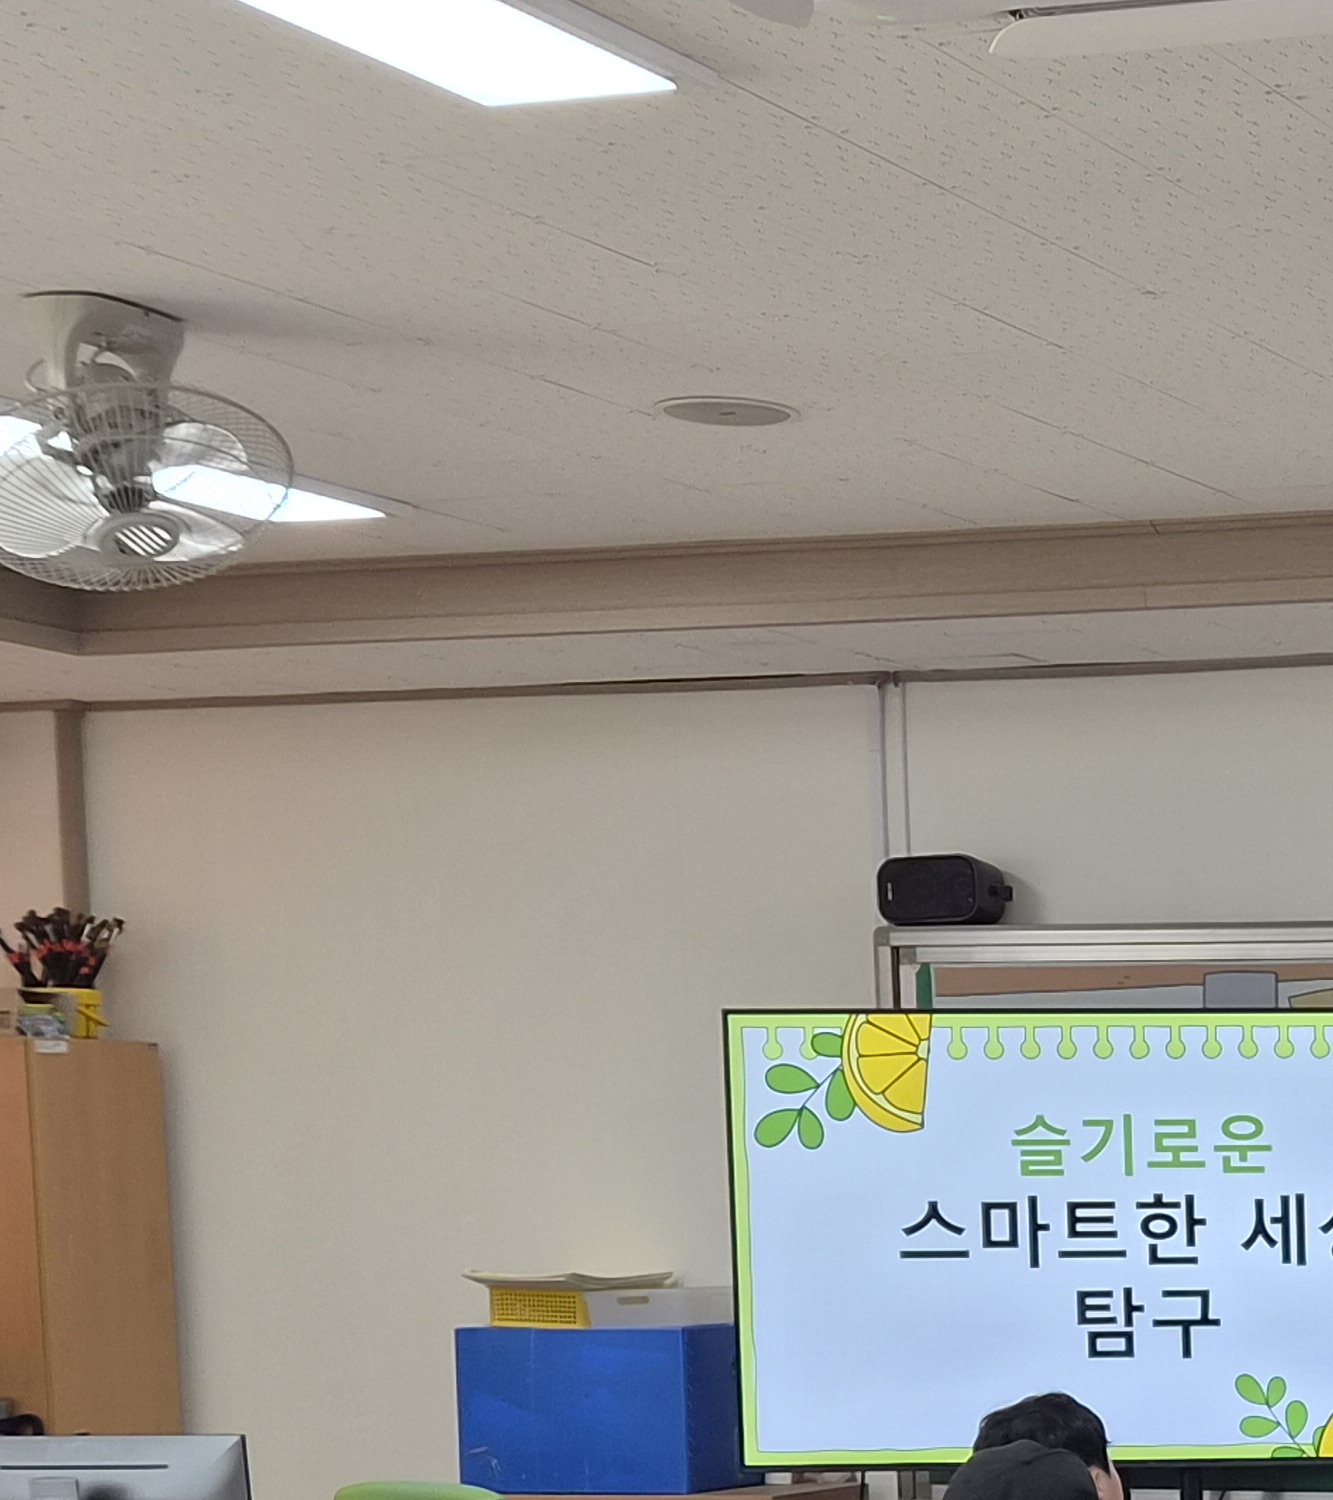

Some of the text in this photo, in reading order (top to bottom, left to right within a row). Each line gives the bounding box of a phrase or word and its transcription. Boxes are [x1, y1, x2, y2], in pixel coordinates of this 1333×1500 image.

[1011, 1114, 1273, 1177] 슬기로운
[900, 1194, 1206, 1268] 스마트한
[1076, 1287, 1221, 1358] 탐구
